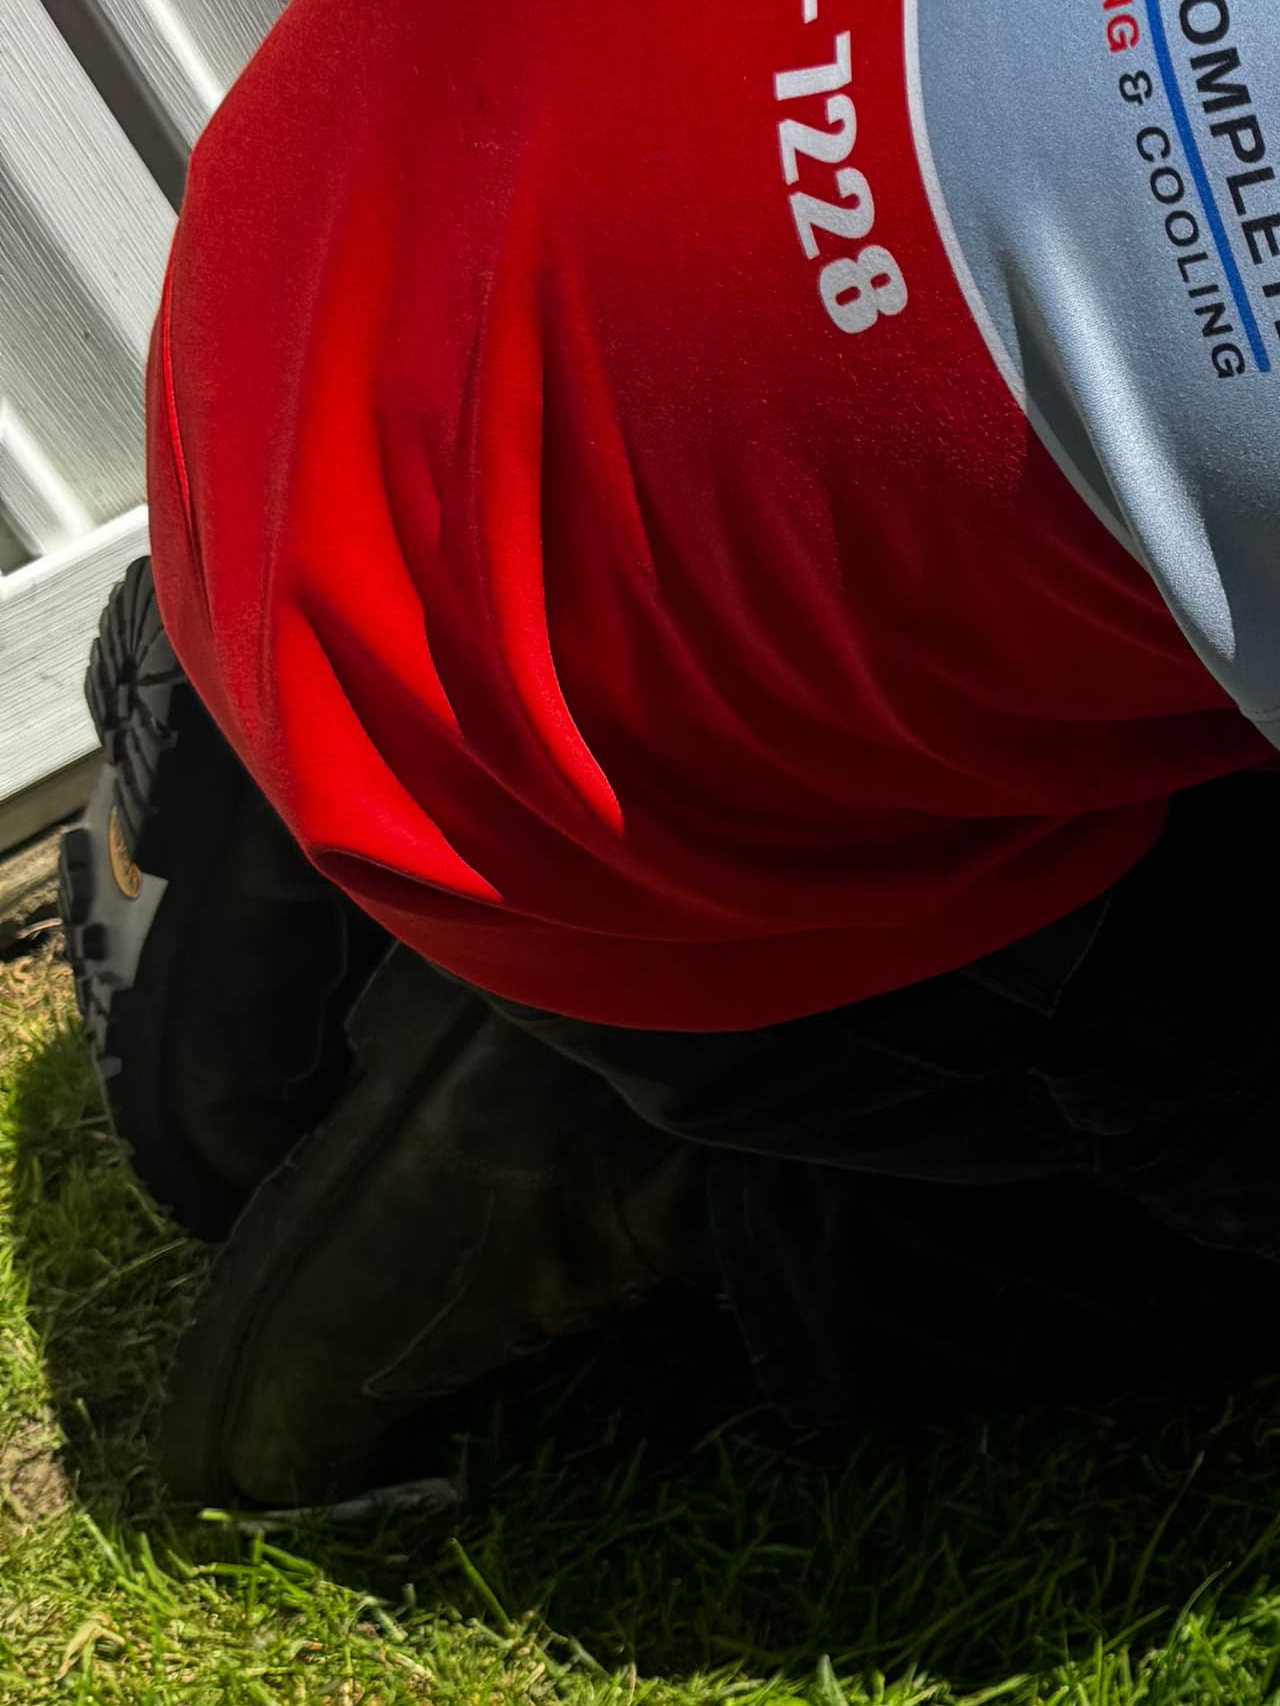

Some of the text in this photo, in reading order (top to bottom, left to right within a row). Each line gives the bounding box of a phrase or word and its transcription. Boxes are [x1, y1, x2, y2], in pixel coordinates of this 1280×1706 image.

[773, 30, 908, 336] 7228
[1118, 70, 1153, 106] &
[1136, 126, 1247, 379] COOLING
